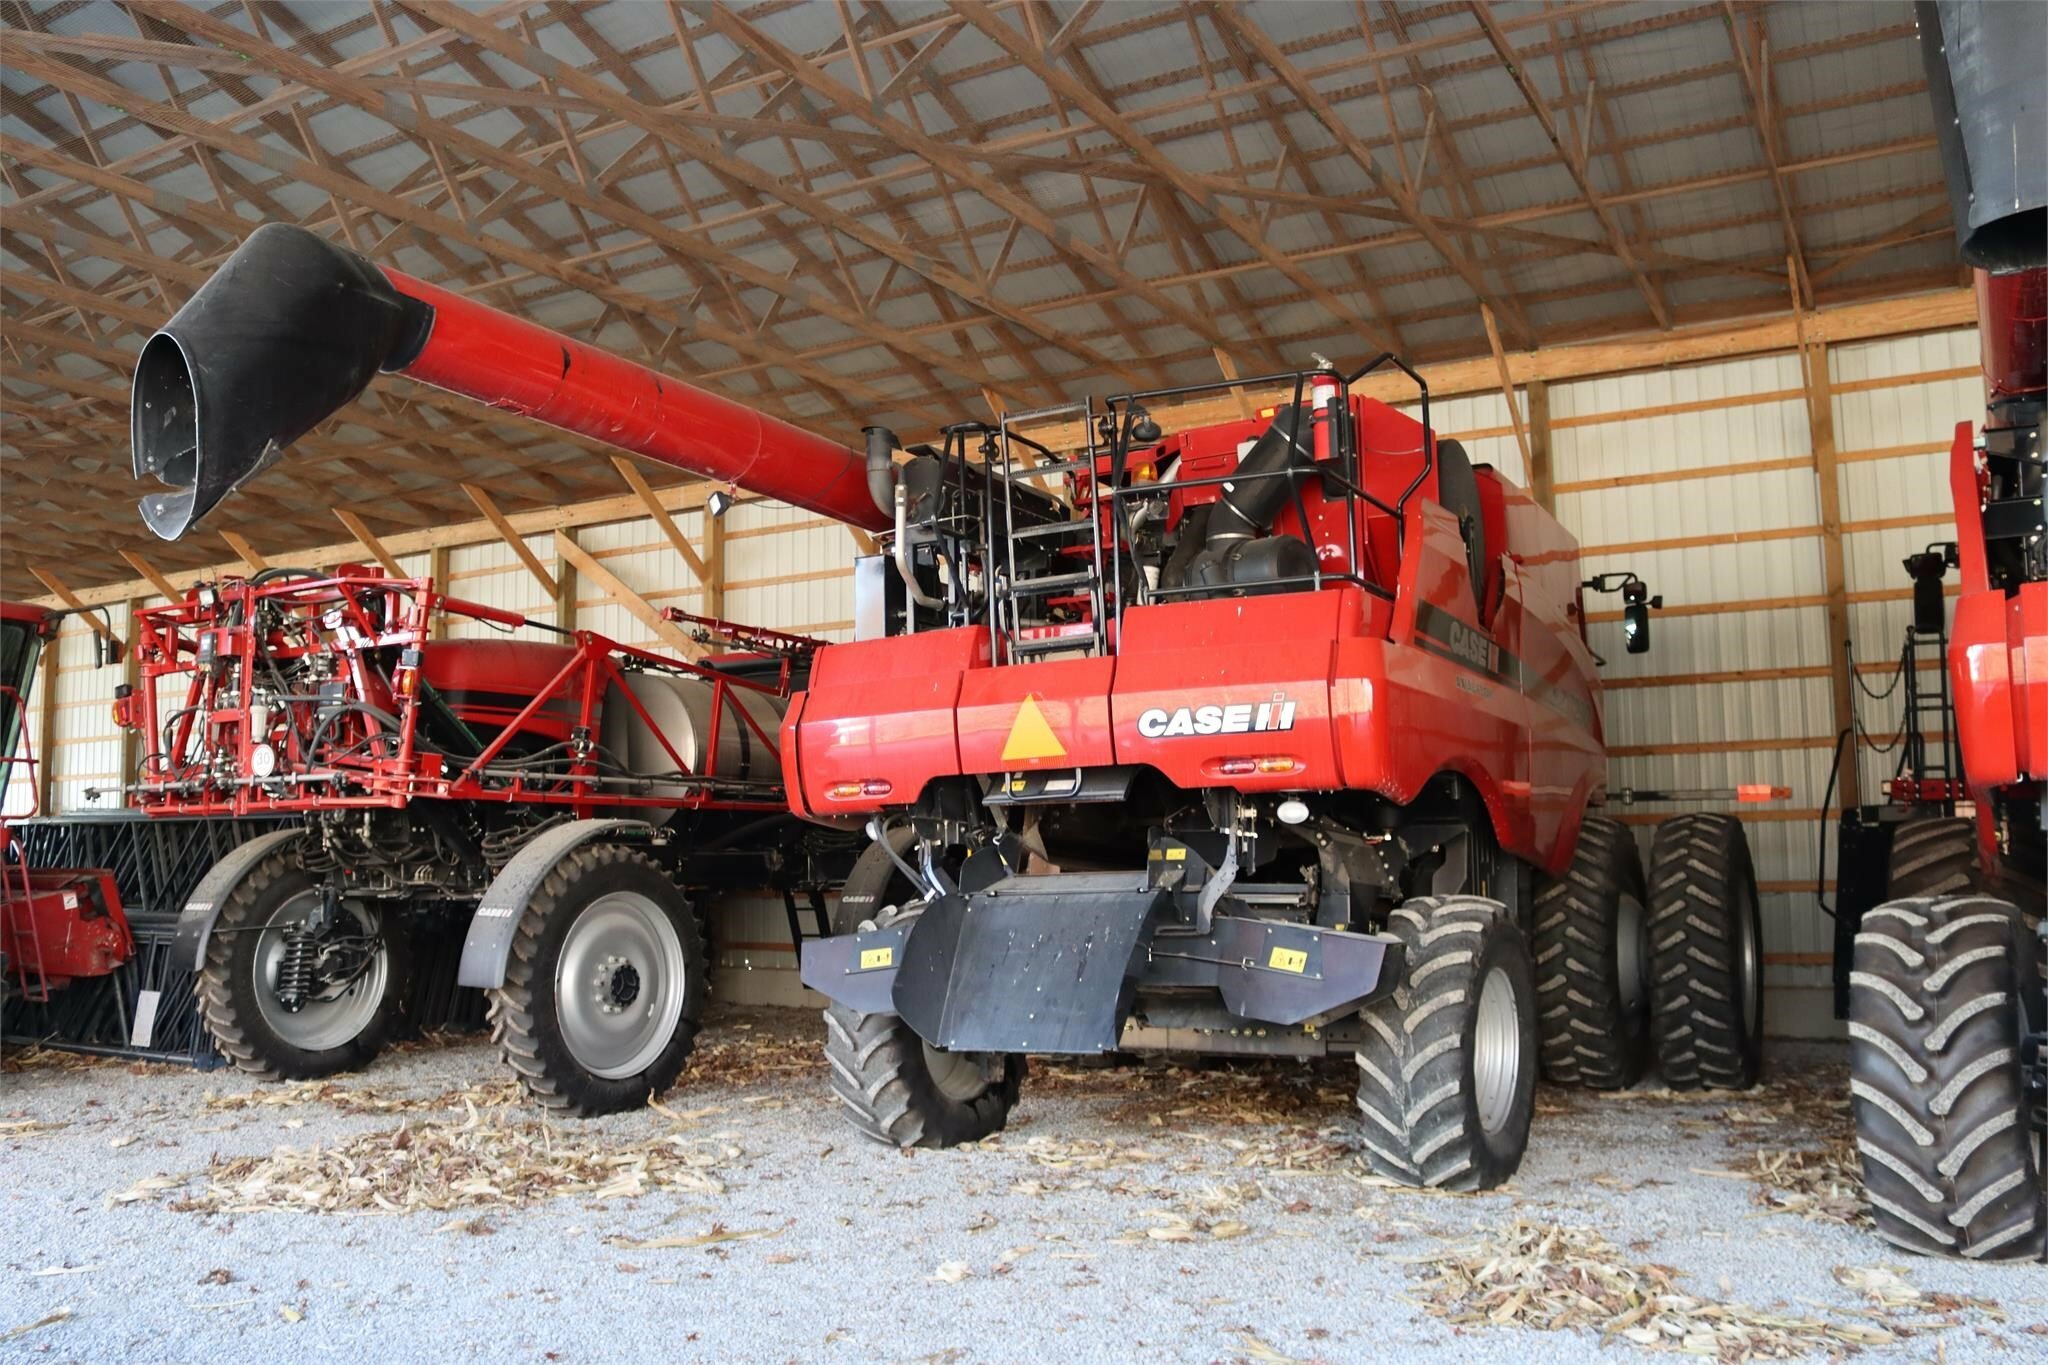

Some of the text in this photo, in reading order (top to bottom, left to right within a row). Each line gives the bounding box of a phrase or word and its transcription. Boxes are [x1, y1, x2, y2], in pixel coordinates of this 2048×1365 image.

[1449, 620, 1488, 668] CASE
[1138, 704, 1252, 737] CASE
[256, 751, 271, 766] 30
